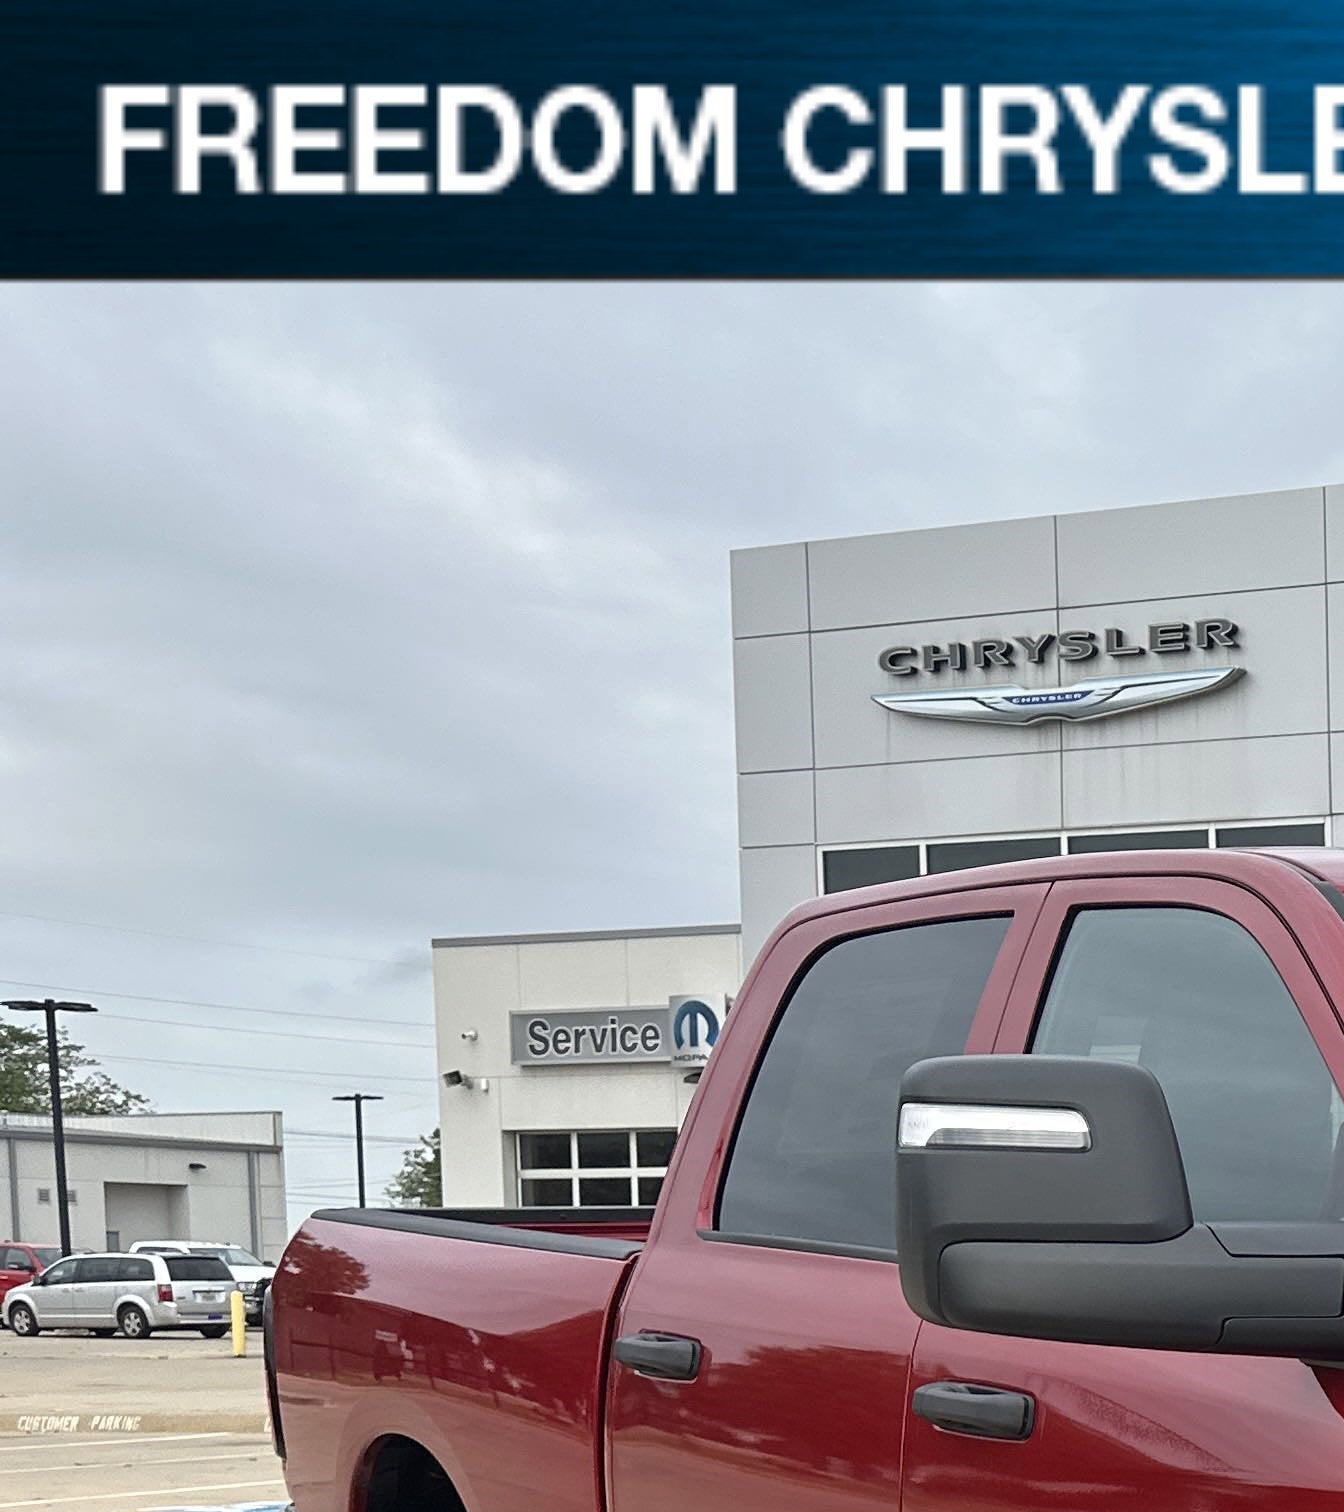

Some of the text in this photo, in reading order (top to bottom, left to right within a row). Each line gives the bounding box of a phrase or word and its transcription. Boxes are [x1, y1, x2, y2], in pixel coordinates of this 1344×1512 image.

[877, 616, 1241, 676] CHRYSLER
[1012, 693, 1082, 704] CHRYSLER
[527, 1015, 662, 1058] Service
[673, 1053, 709, 1062] MOPA
[17, 1415, 142, 1433] CUSTOMER PARKING
